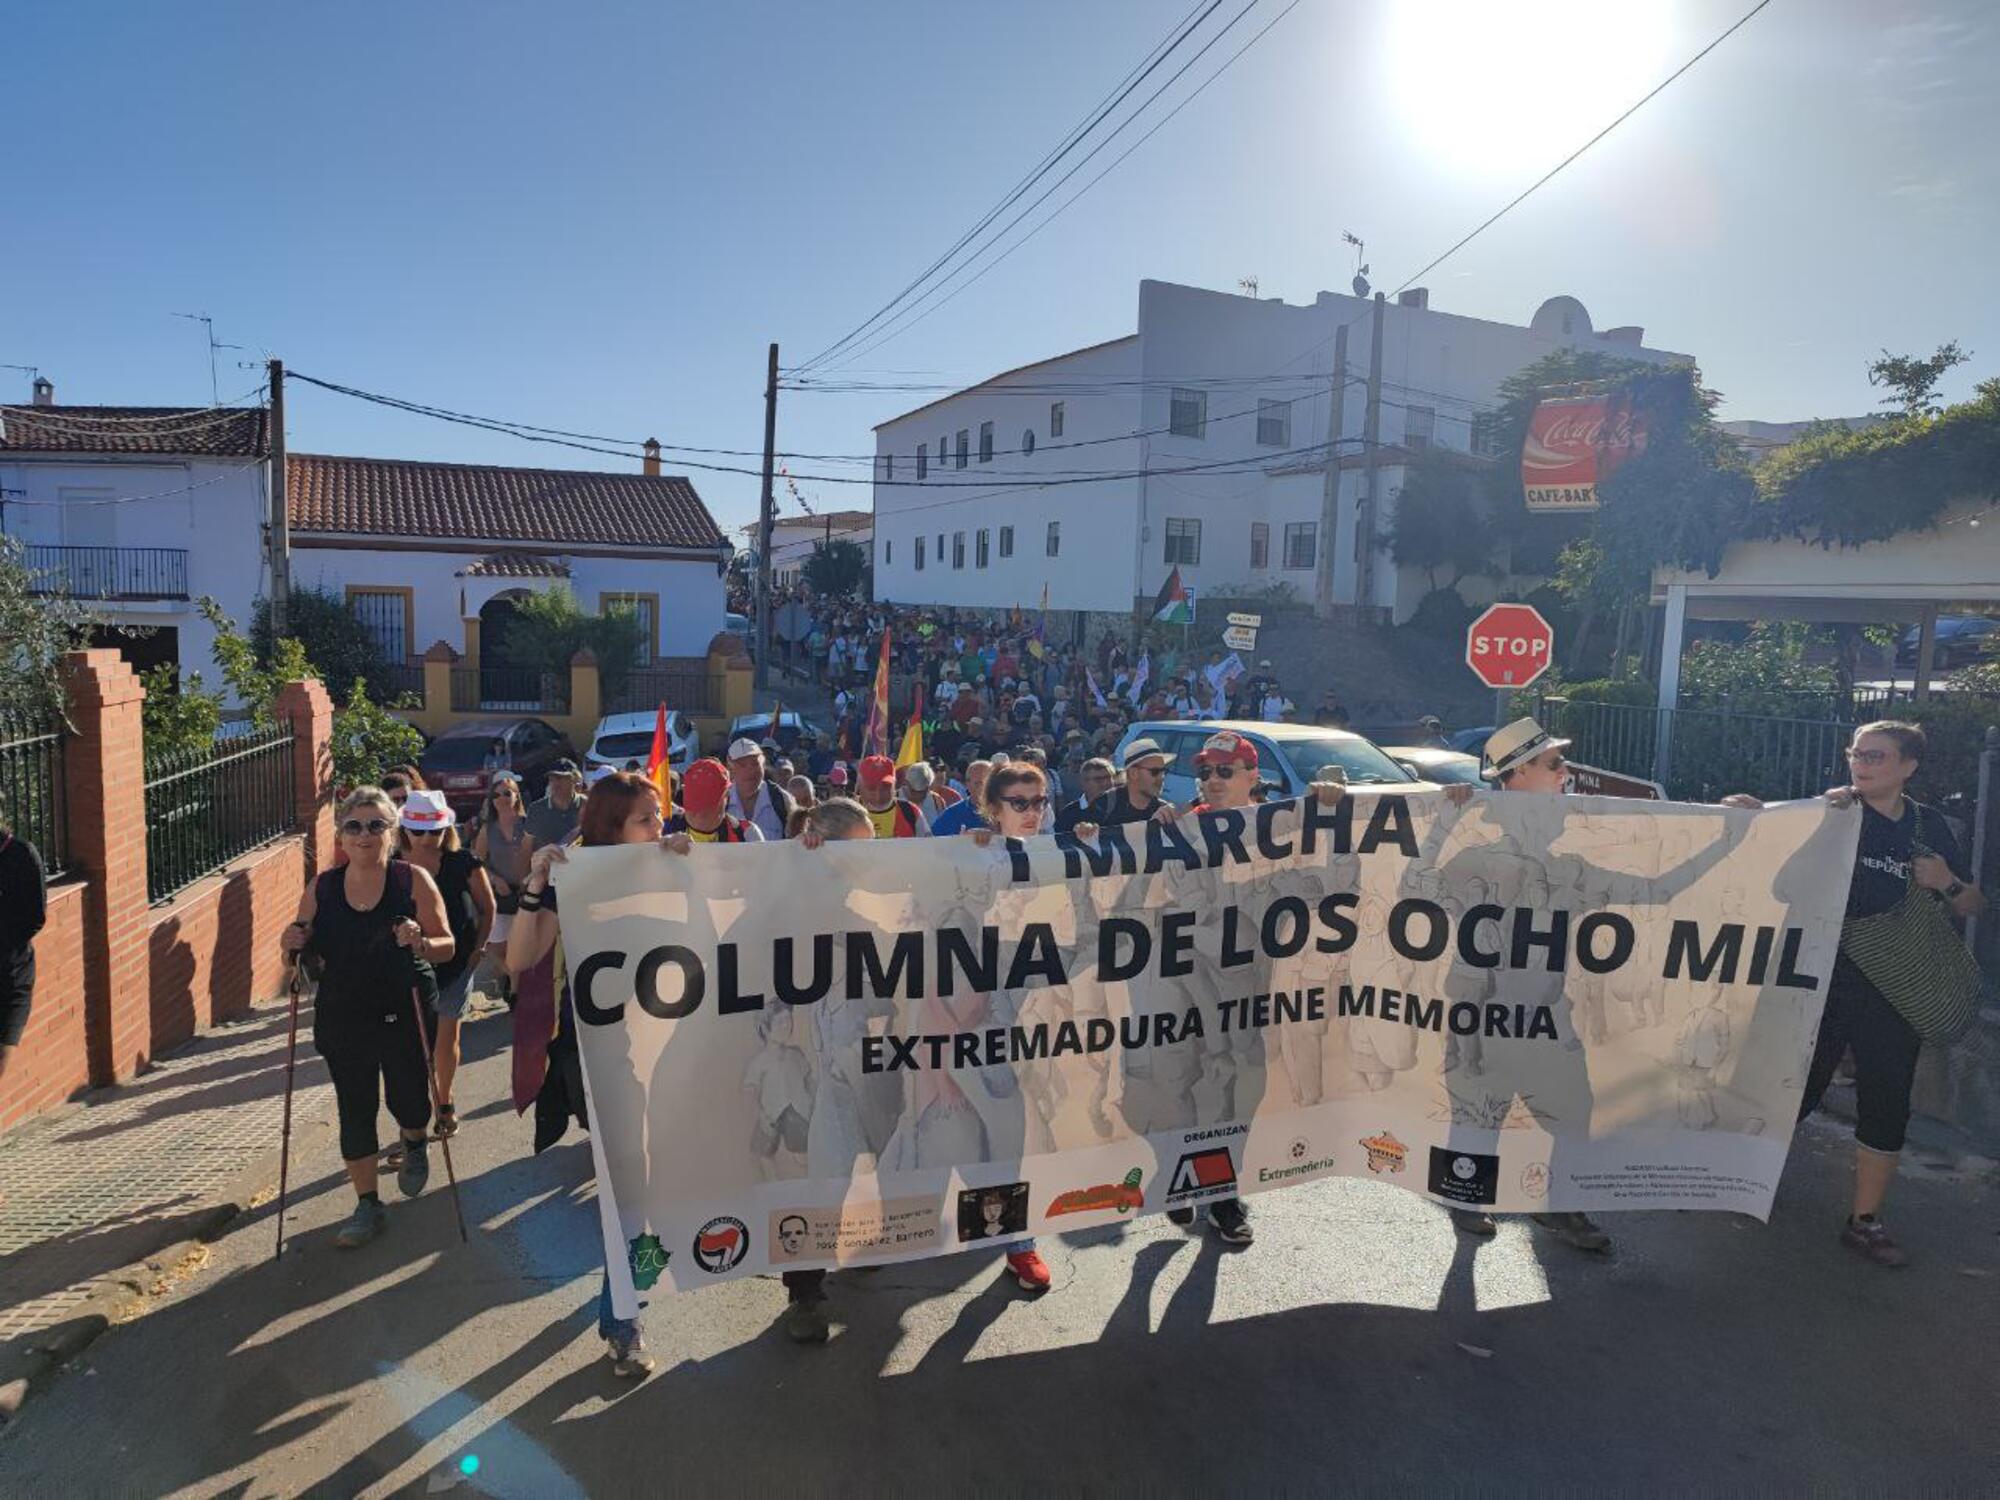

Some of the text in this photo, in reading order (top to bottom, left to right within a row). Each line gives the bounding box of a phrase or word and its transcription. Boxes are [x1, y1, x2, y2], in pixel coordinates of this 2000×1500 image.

[1474, 636, 1546, 657] STOP
[1578, 772, 1600, 788] MINA
[1056, 796, 1419, 878] MARCHA
[573, 893, 1818, 1026] COLUMNA DE LOS OCHO MIL
[862, 986, 1558, 1074] EXTREMADURA TIENE MEMORIA
